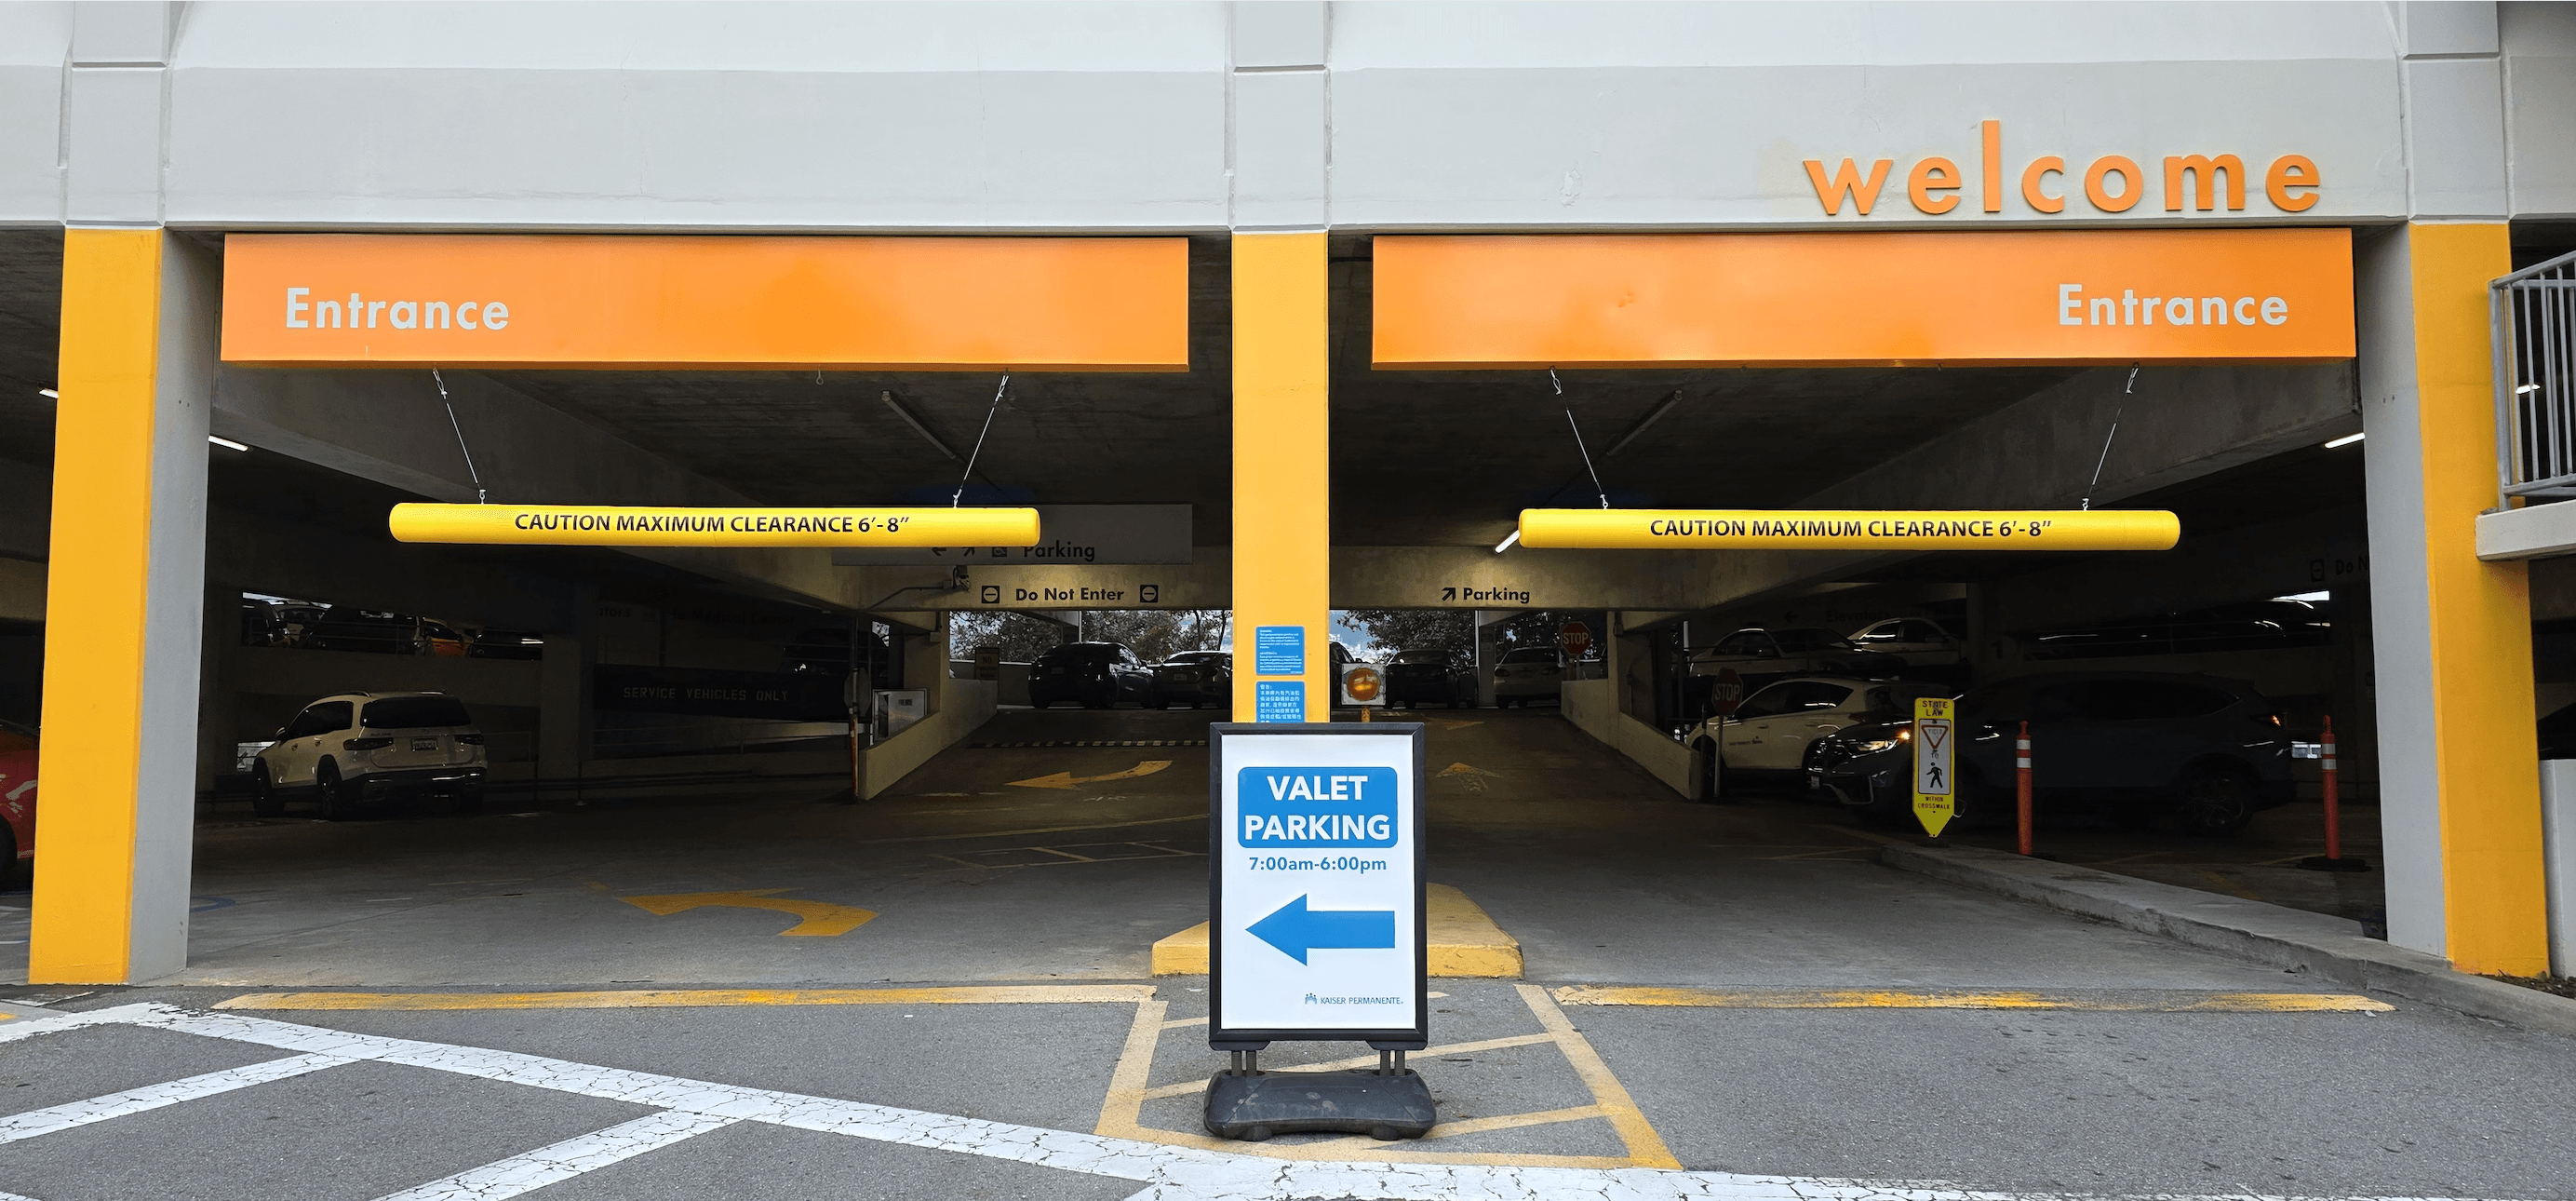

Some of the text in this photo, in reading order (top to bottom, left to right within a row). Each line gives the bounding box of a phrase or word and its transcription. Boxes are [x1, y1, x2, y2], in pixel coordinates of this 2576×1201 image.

[1804, 120, 2320, 215] welcome
[286, 287, 509, 331] Entrance
[2059, 283, 2288, 326] Entrance
[515, 514, 610, 531] CAUTION
[616, 515, 725, 533] MAXIMUM
[731, 516, 853, 533] CLEARANCE
[1650, 520, 1746, 536] CAUTION
[1751, 520, 1862, 537] MAXIMUM
[1867, 520, 1993, 537] CLEARANCE
[1024, 539, 1095, 562] Parking
[1015, 587, 1125, 601] Do Not Enter
[1463, 587, 1531, 604] Parking
[1563, 632, 1589, 645] STOP
[623, 686, 788, 702] SERVICE VEHICLES ONLY
[1714, 683, 1741, 700] STOP
[1925, 708, 1943, 717] LAW
[1266, 775, 1369, 801] VALET
[1244, 815, 1391, 841] PARKING
[1249, 857, 1387, 874] 7:00am-6:00pm
[1320, 996, 1347, 1005] KAISER
